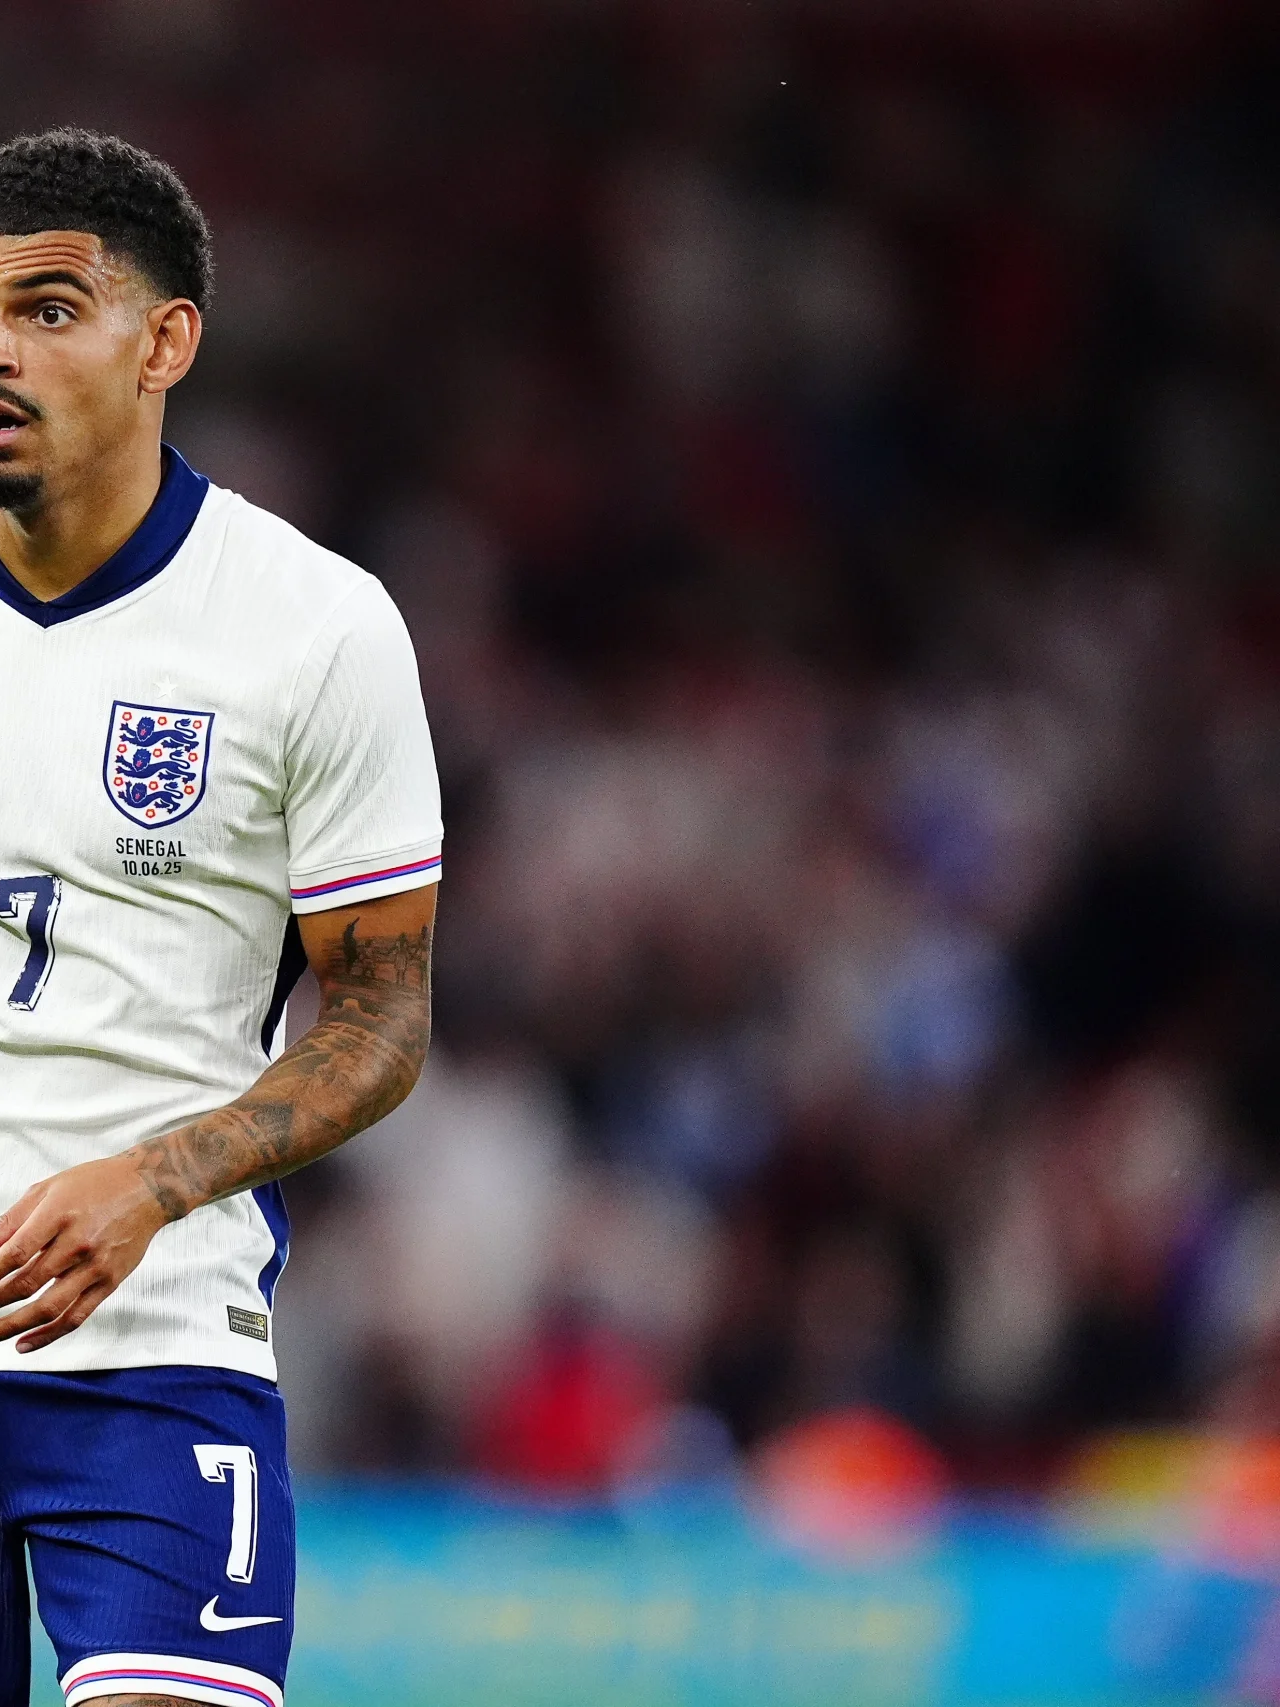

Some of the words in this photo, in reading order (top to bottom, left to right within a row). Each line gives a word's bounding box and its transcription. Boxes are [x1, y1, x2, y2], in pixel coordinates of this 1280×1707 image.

[116, 837, 186, 857] SENEGAL
[122, 860, 182, 876] 10.06.25
[193, 1444, 258, 1584] 7
